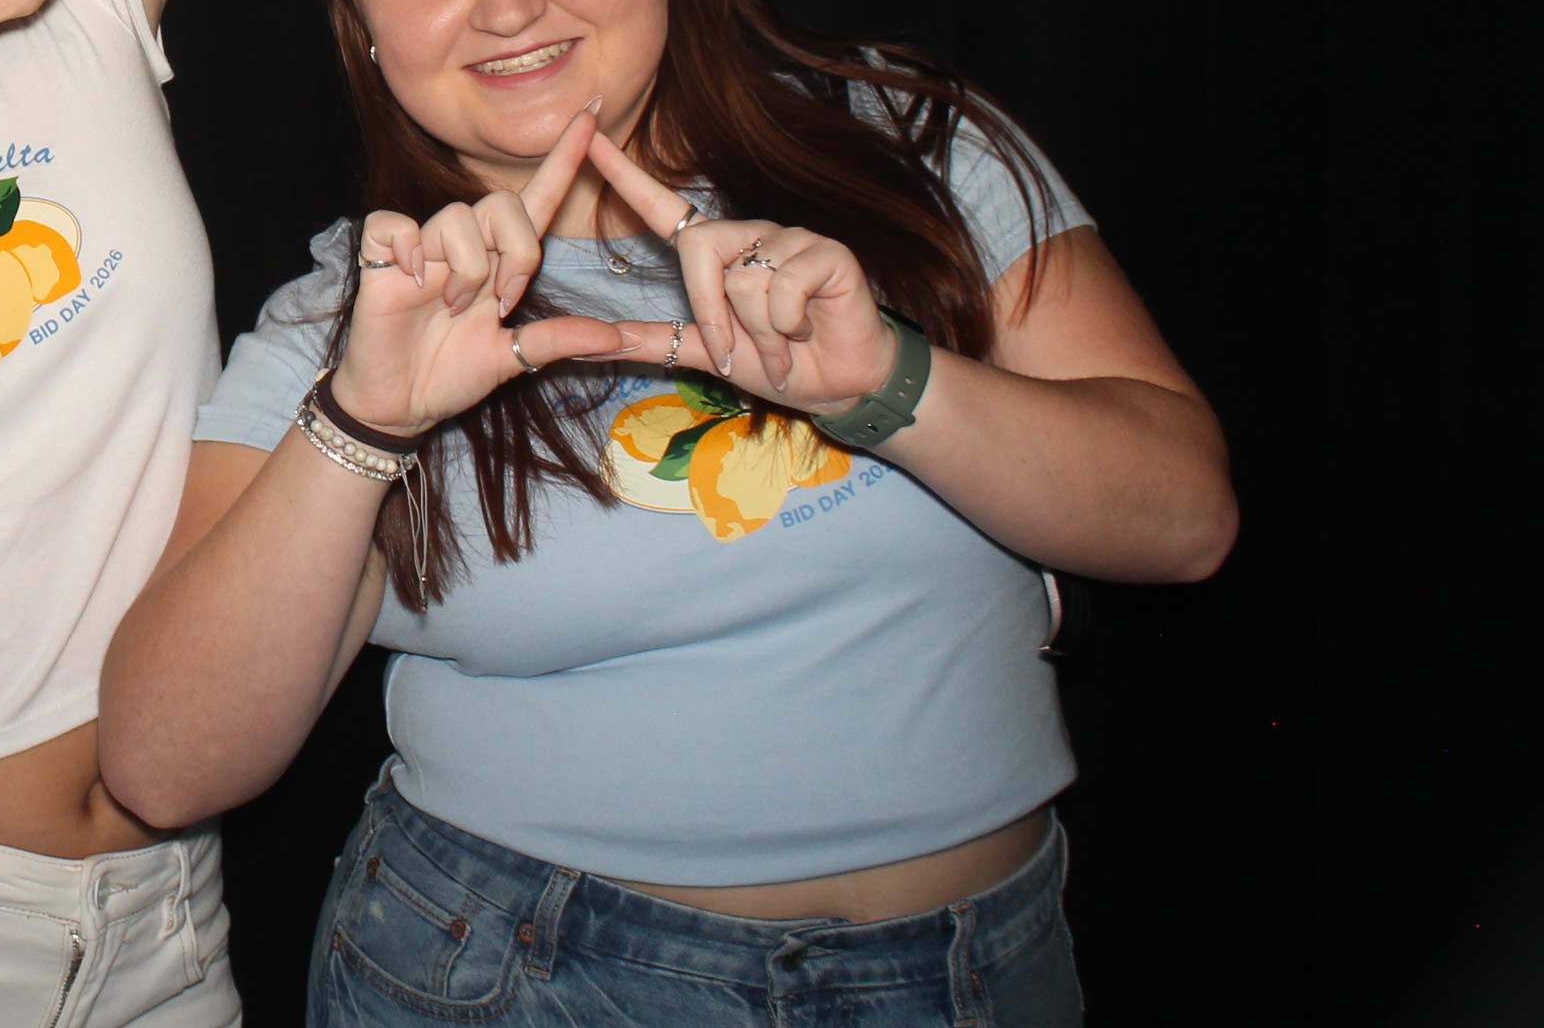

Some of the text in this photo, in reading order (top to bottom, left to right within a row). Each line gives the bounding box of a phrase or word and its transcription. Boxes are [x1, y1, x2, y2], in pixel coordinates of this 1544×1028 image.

[28, 249, 123, 345] BID DAY 2026
[779, 504, 815, 528] BID
[817, 480, 856, 513] DAY
